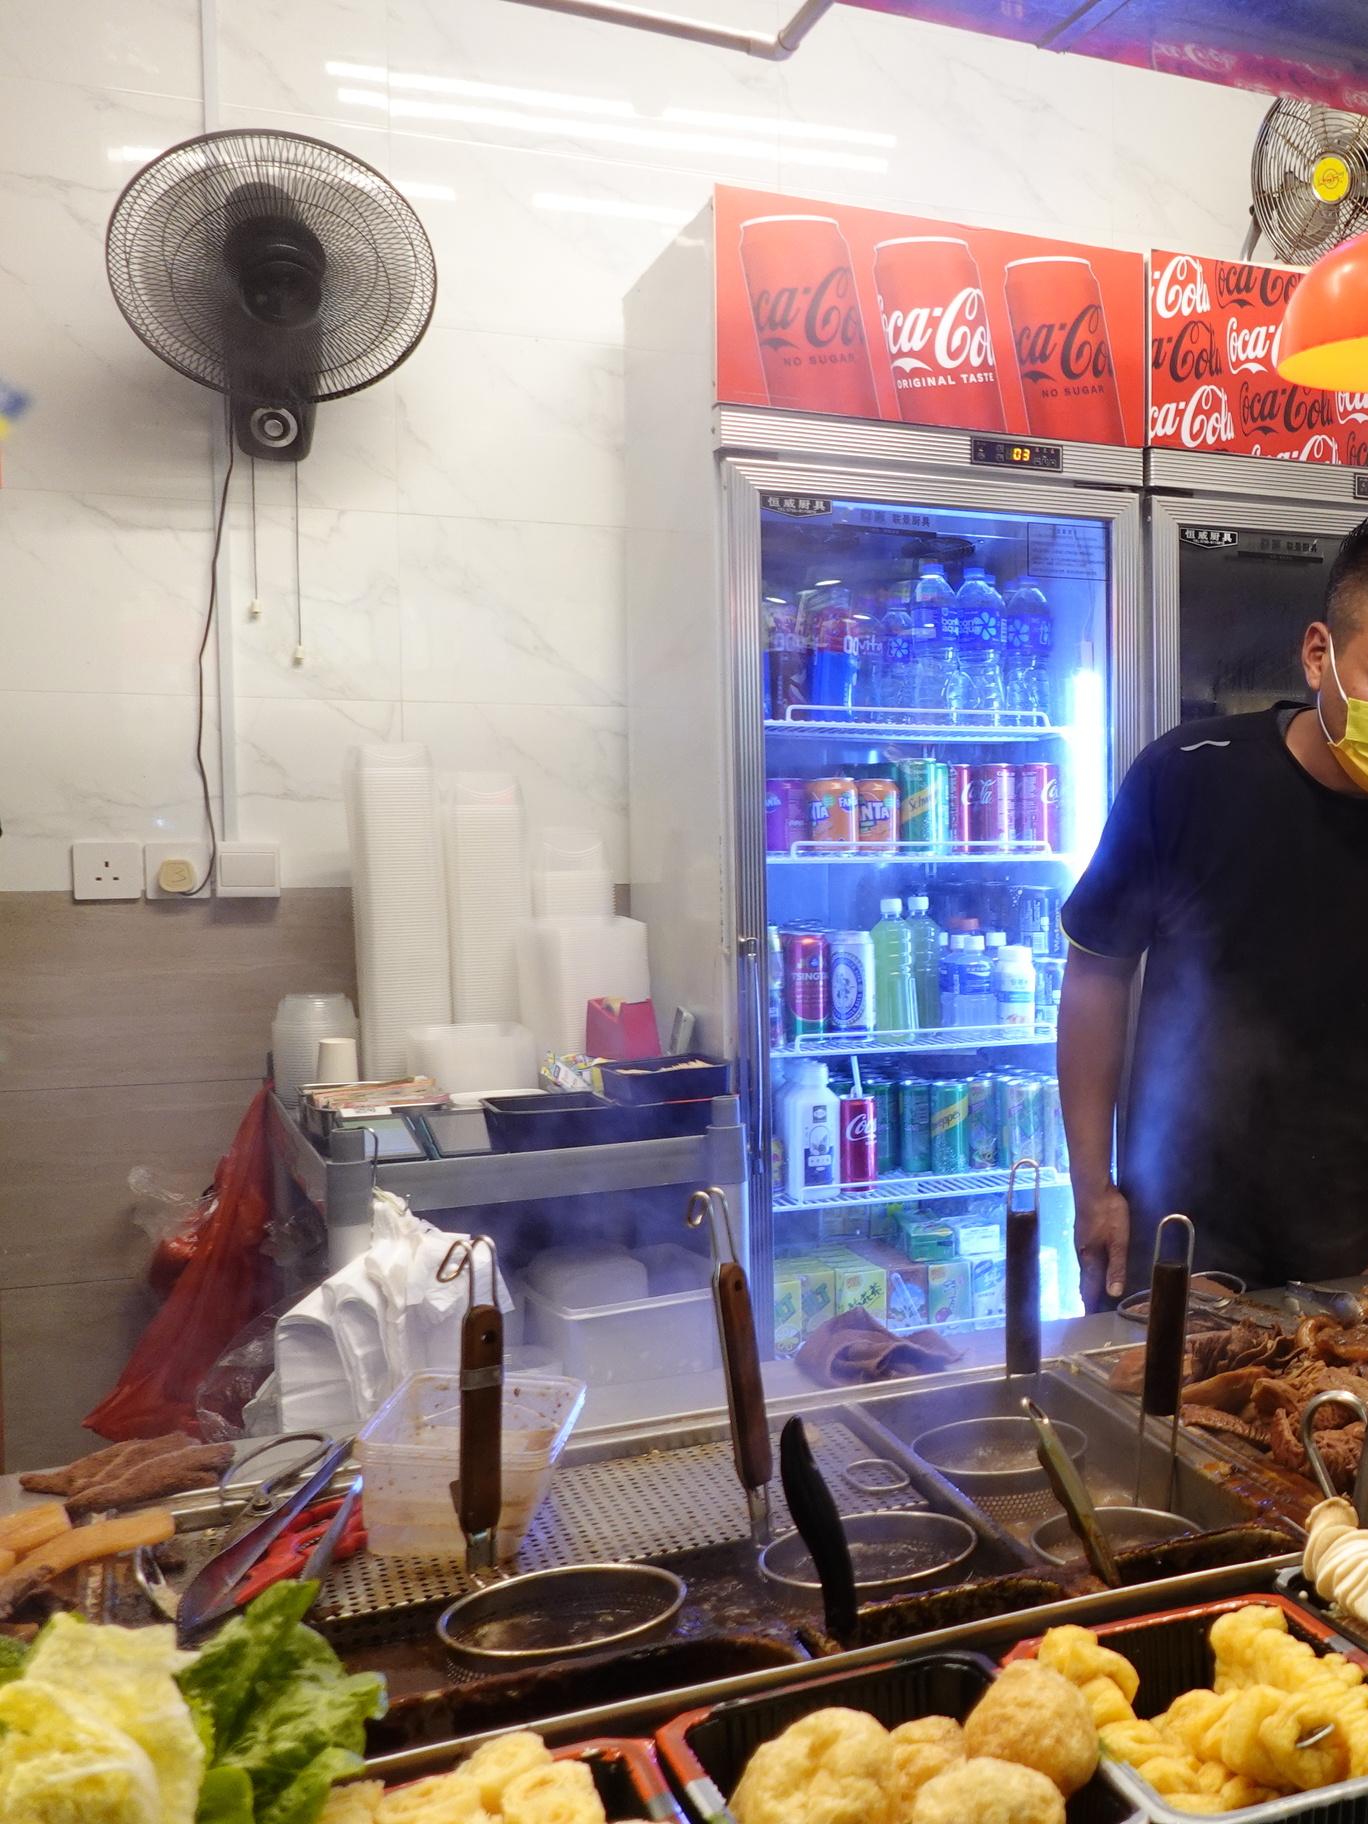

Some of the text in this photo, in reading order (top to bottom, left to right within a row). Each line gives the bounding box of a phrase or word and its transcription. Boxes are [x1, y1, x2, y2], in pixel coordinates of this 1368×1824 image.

[961, 372, 994, 384] TASTE
[1042, 385, 1105, 398] NO SUGAR
